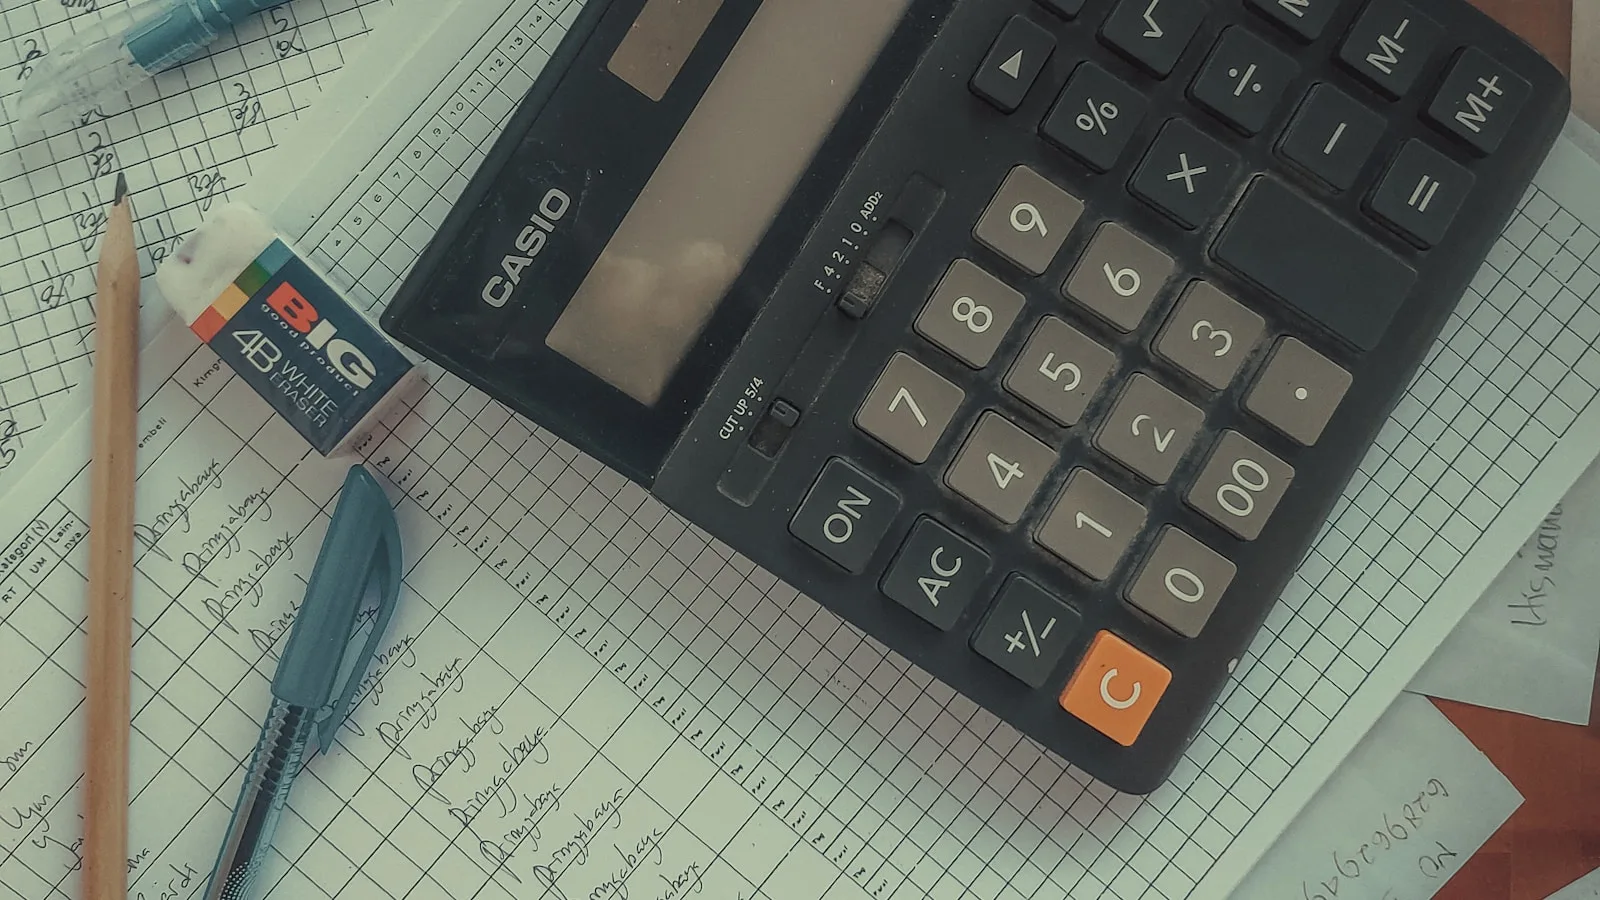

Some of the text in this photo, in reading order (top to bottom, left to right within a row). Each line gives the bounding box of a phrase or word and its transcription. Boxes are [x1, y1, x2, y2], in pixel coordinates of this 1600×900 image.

[1010, 203, 1049, 238] 9
[482, 187, 571, 309] CASIO
[813, 278, 826, 292] F
[823, 265, 835, 278] 4
[832, 251, 845, 263] 2
[841, 237, 854, 249] 1
[1103, 262, 1142, 298] 6
[265, 280, 377, 391] BIG
[952, 296, 994, 333] 8
[231, 328, 283, 375] 4B
[260, 303, 359, 398] good product
[1191, 320, 1233, 357] 3
[281, 359, 339, 415] WHITE
[1039, 352, 1082, 391] 5
[270, 372, 329, 429] ERASER
[718, 376, 765, 440] CUT UP 5/4
[888, 387, 928, 427] 7
[138, 417, 168, 449] embeli
[1131, 414, 1176, 453] 2
[987, 452, 1024, 489] 4
[1217, 459, 1269, 517] 00
[822, 485, 872, 544] ON
[1076, 510, 1113, 538] 1
[917, 546, 962, 607] AC
[1164, 567, 1205, 603] 0
[1100, 668, 1142, 710] C
